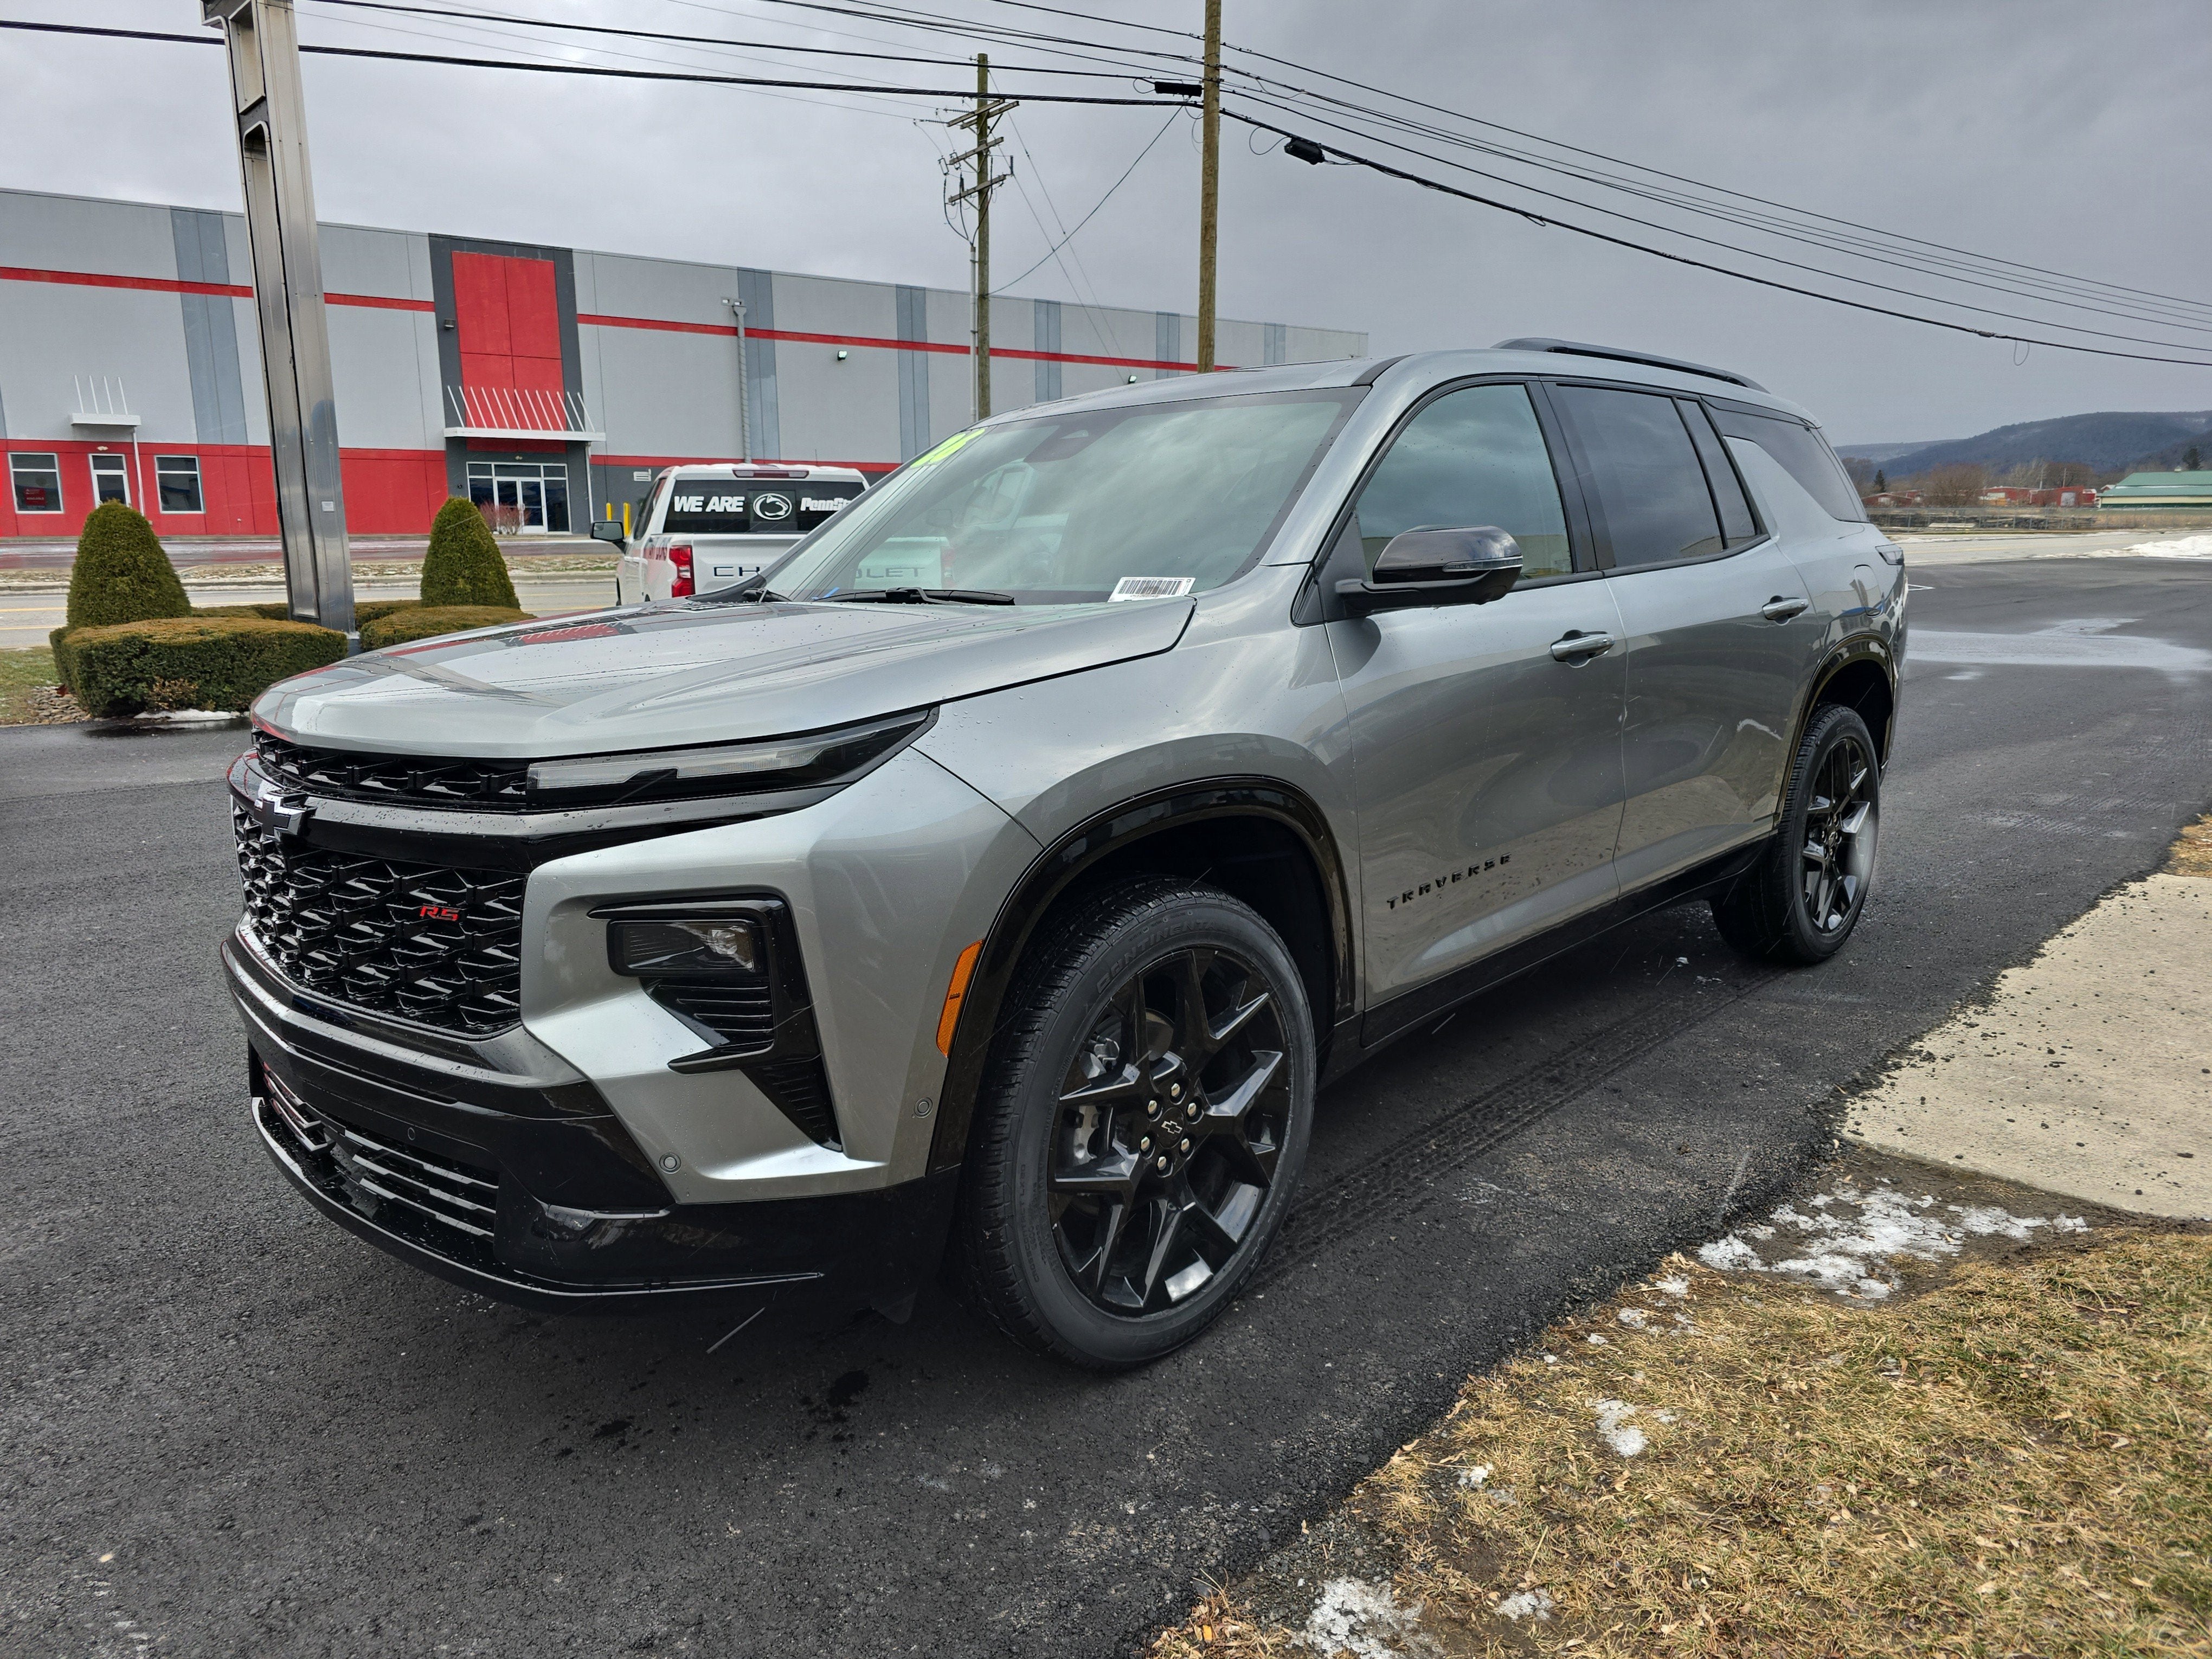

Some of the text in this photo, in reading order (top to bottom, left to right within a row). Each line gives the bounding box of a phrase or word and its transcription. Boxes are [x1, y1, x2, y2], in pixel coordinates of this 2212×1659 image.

[674, 496, 852, 512] WE ARE PennSt
[1387, 852, 1512, 910] TRAVERSE
[420, 905, 459, 921] RS
